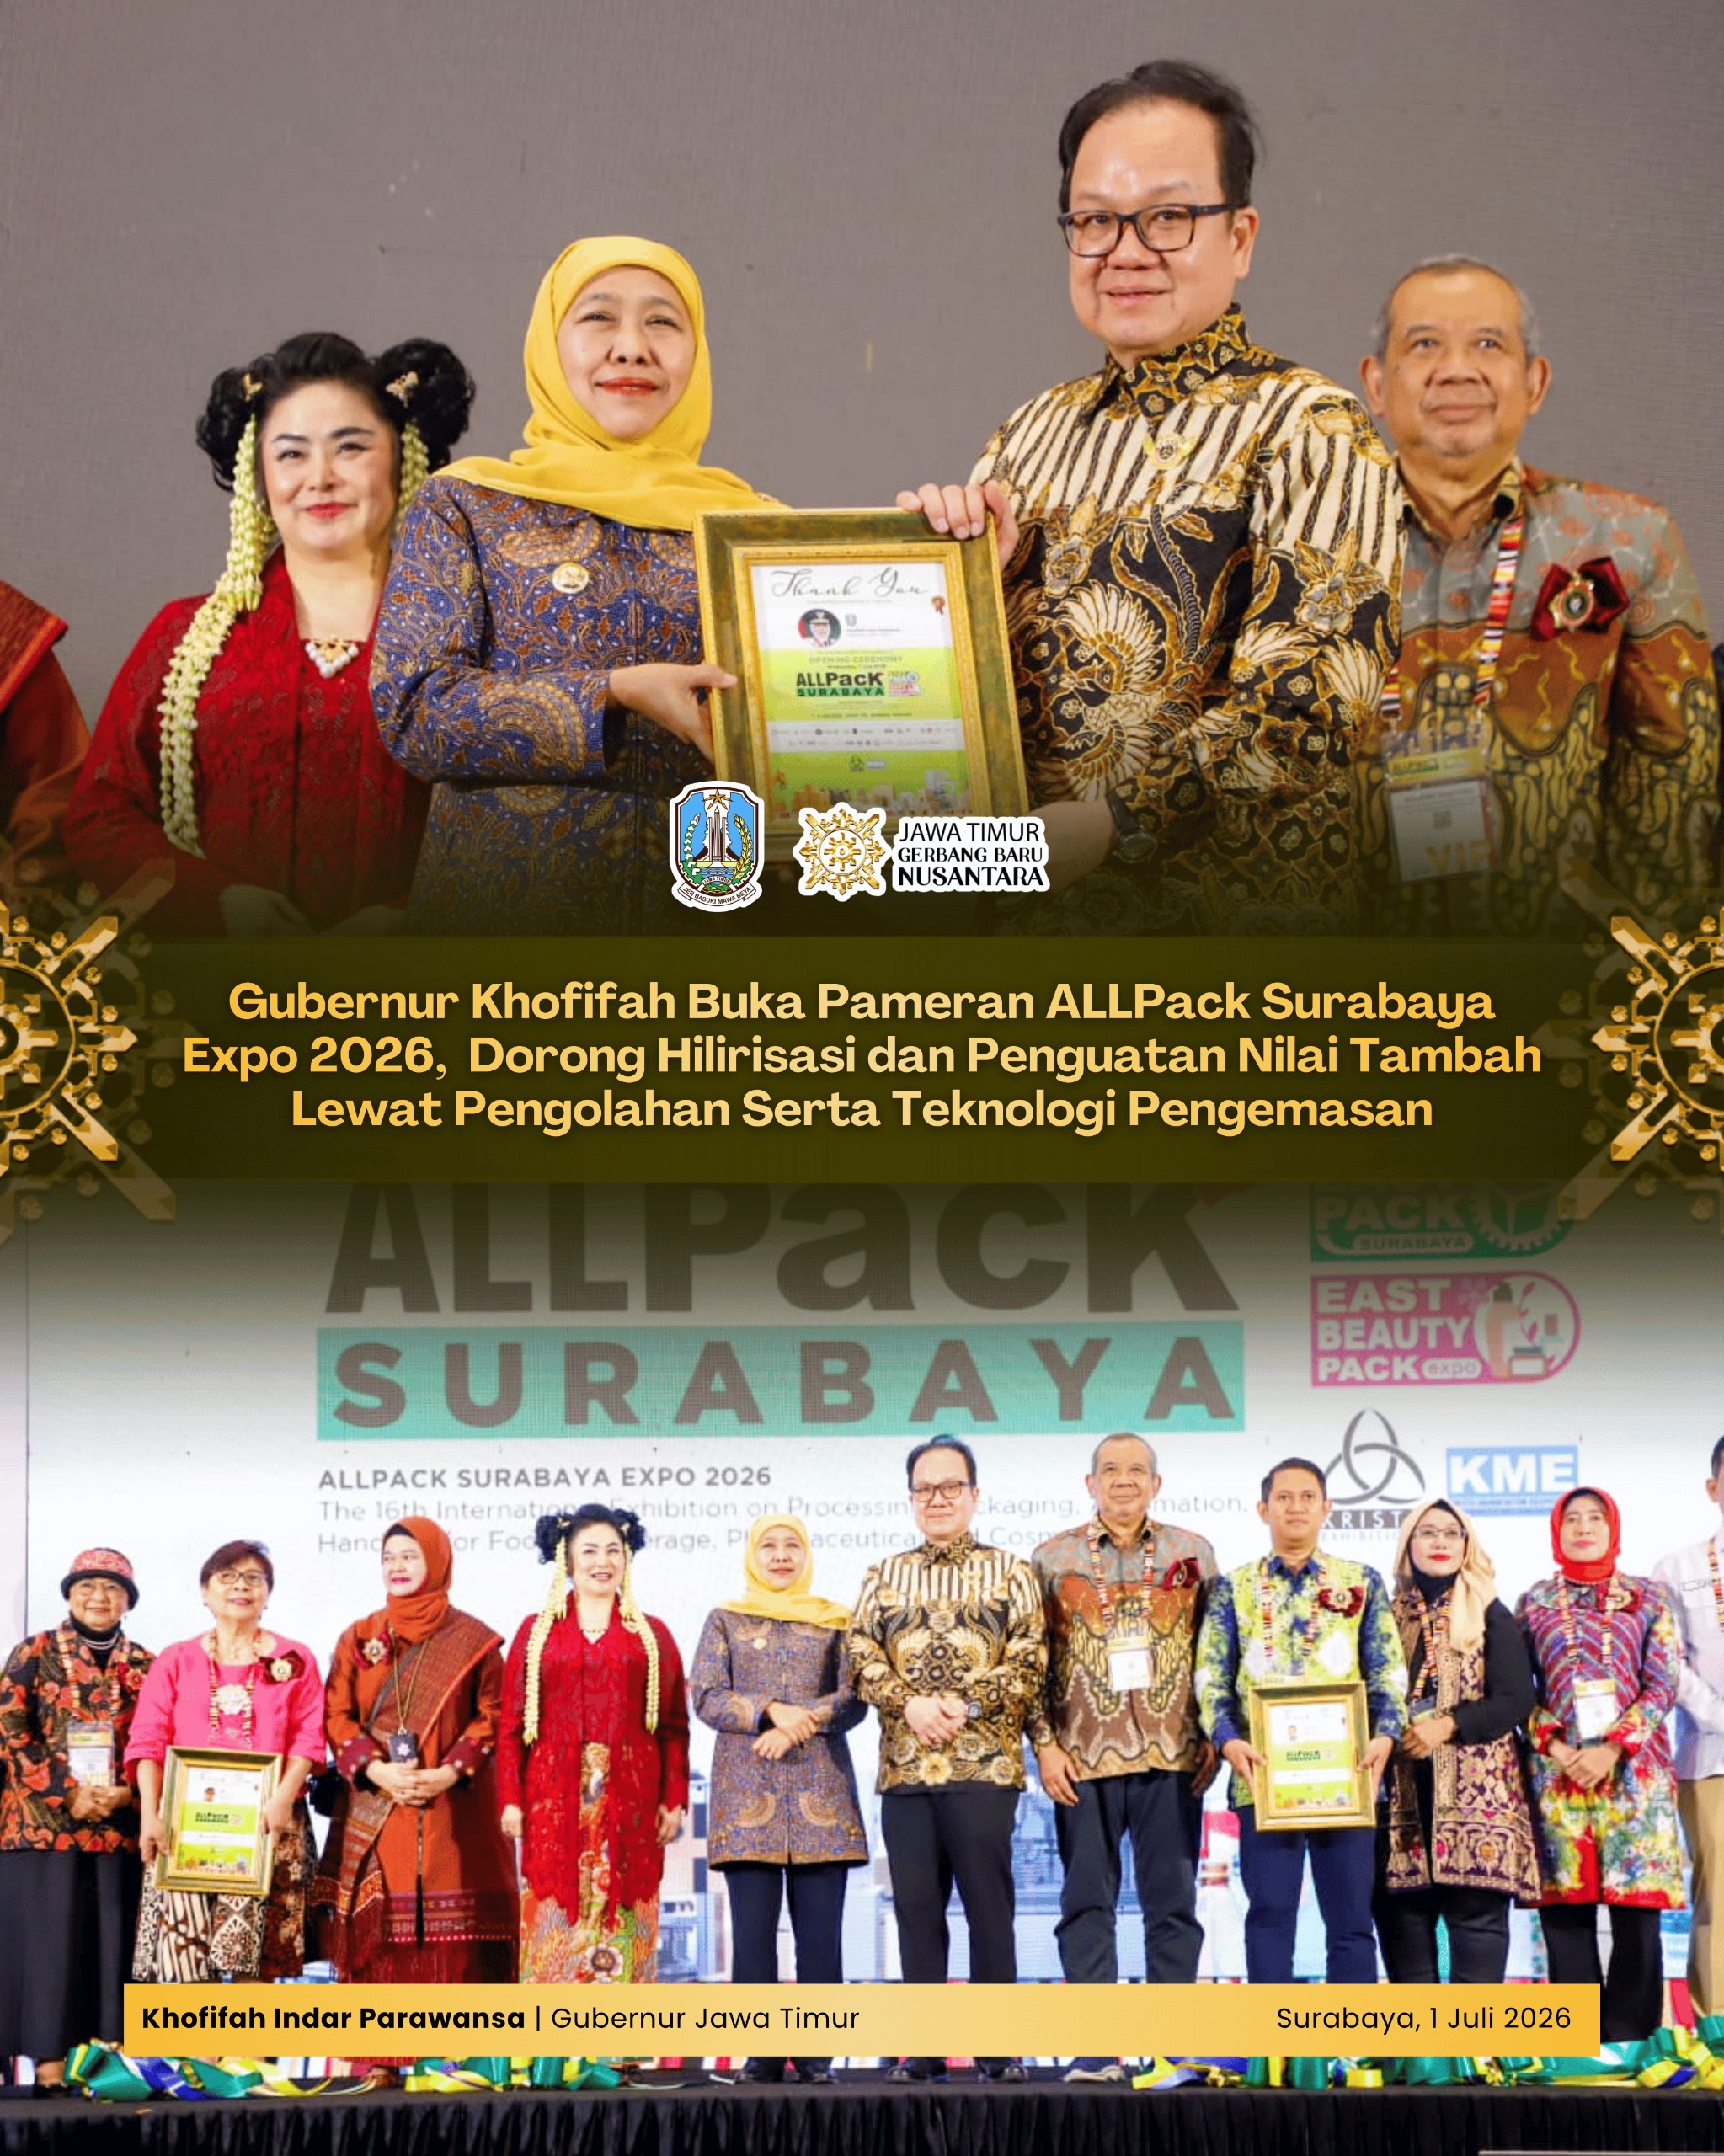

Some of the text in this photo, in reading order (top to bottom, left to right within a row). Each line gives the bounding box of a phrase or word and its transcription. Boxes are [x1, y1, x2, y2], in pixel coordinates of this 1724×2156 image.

[771, 566, 928, 597] Thank You
[798, 687, 884, 696] SURABAYA
[1316, 1194, 1466, 1231] PACK
[1358, 1236, 1466, 1251] SURABAYA
[1317, 1278, 1452, 1313] EAST
[1317, 1316, 1471, 1351] BEAUTY
[333, 1336, 1236, 1428] SURABAYA
[1318, 1354, 1477, 1382] PACK expo
[318, 1467, 771, 1490] ALLPACK SURABAYA EXPO 2026
[1450, 1454, 1575, 1494] KME
[317, 1500, 366, 1521] The
[376, 1500, 427, 1520] 16th
[746, 1502, 778, 1517] on
[788, 1496, 910, 1518] Processin
[1148, 1495, 1248, 1513] mation,
[1321, 1511, 1402, 1529] KRIST
[489, 1530, 536, 1551] Foo
